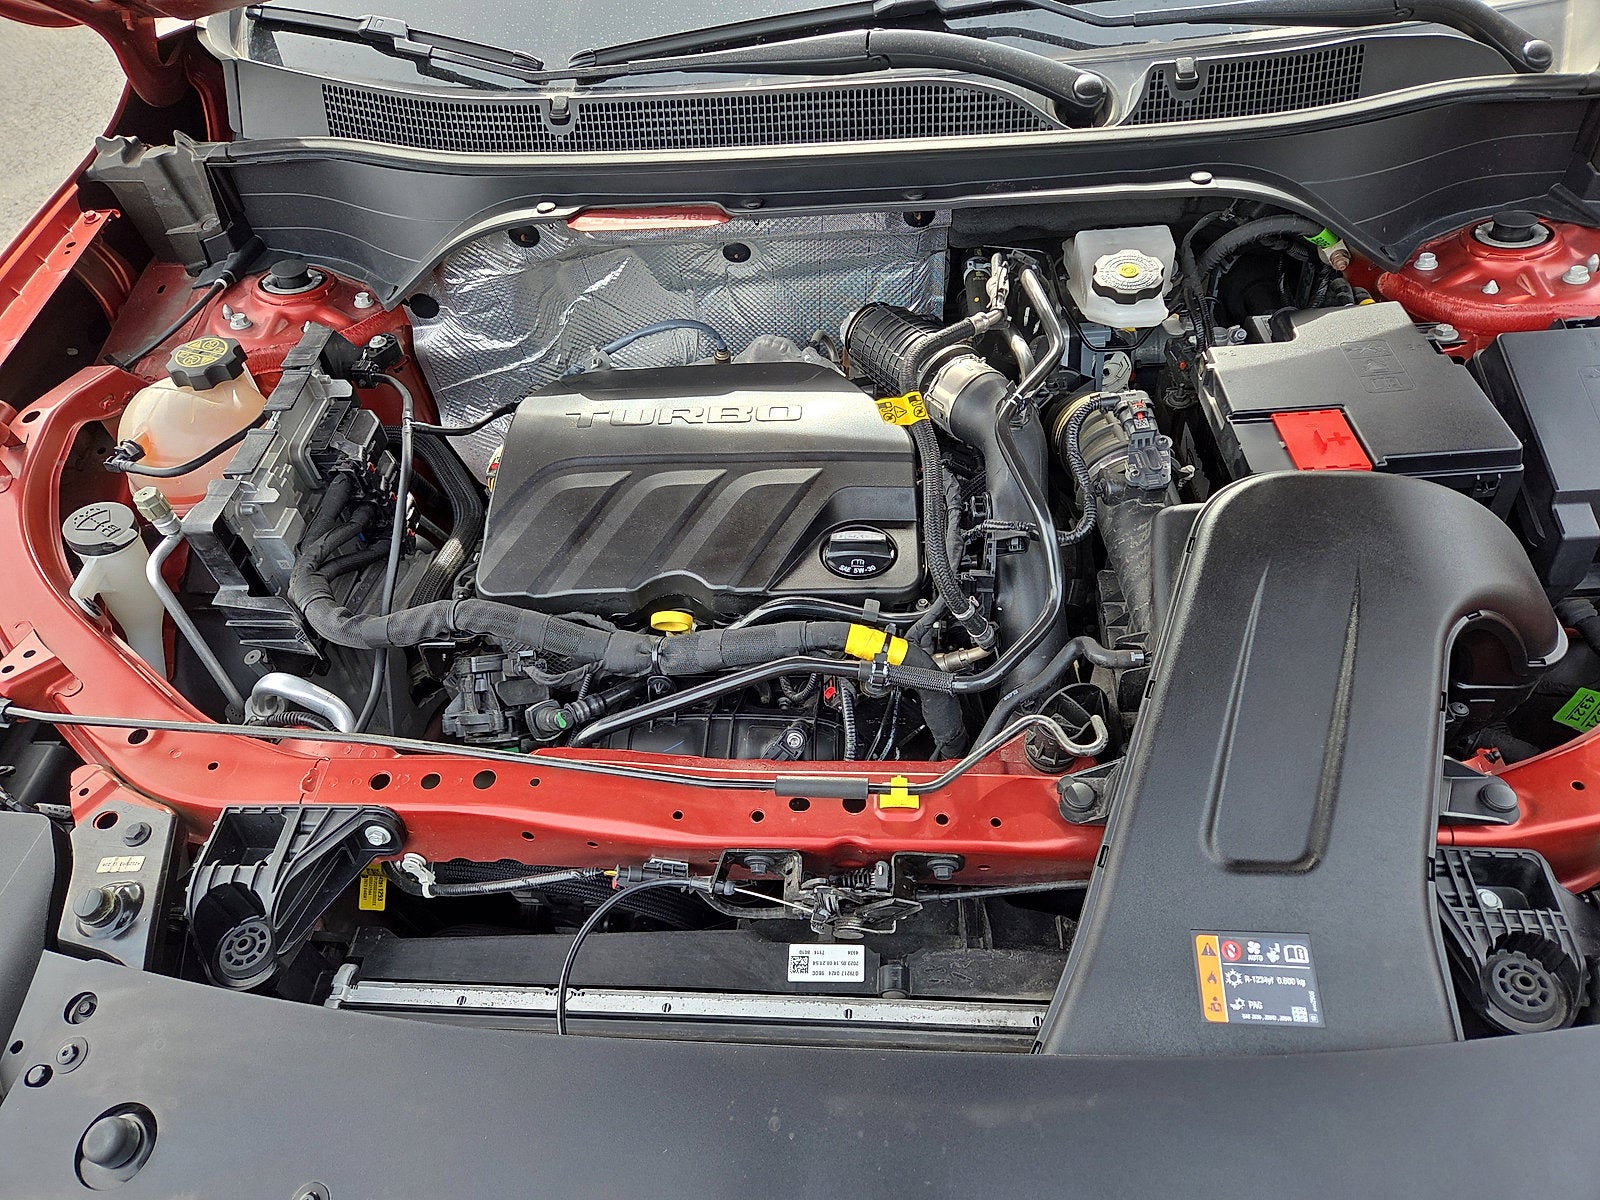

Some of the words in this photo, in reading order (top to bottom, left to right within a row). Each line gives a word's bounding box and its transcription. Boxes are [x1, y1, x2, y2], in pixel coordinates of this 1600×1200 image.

[565, 404, 804, 428] TURBO
[838, 565, 852, 573] SAE
[1568, 696, 1595, 721] 4321
[1297, 978, 1306, 987] kg
[1248, 1000, 1263, 1010] PAG
